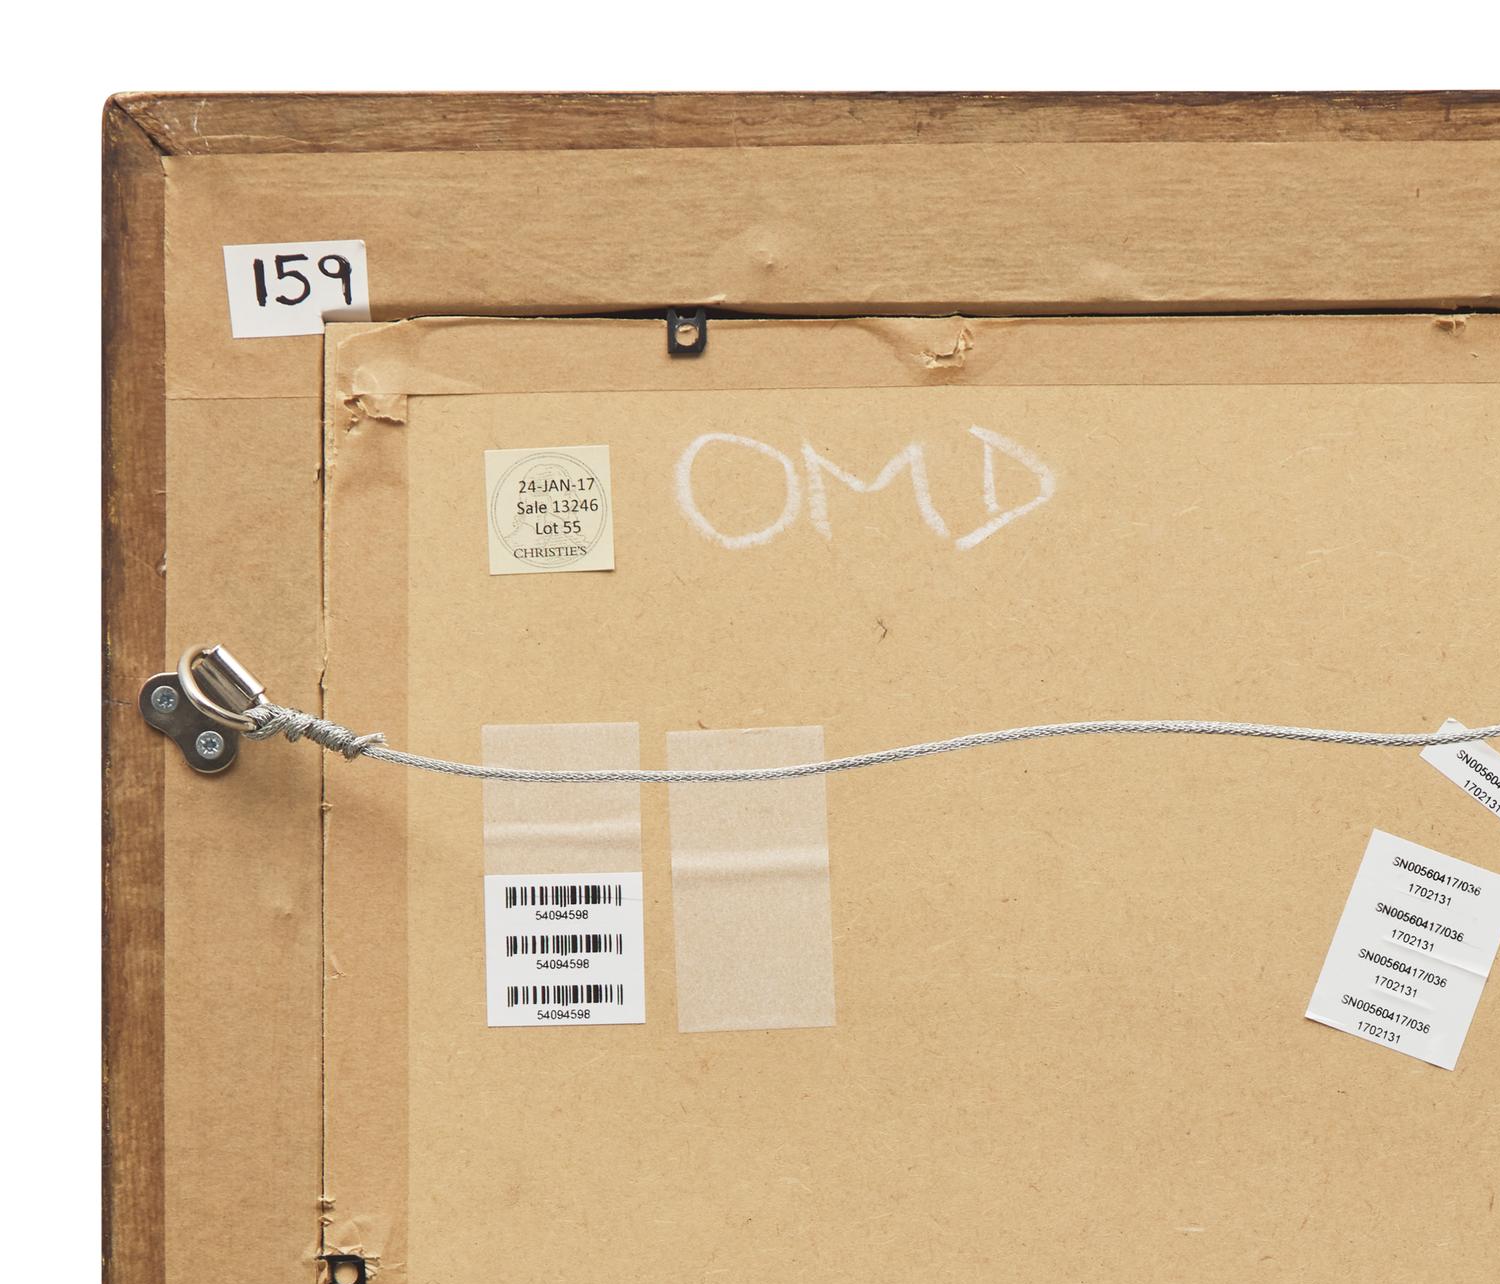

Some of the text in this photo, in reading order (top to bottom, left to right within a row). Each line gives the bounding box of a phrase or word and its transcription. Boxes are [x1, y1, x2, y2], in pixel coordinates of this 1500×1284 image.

[253, 254, 352, 307] 159
[519, 477, 595, 493] 24-JAN-17
[675, 423, 1056, 550] OMD
[517, 498, 599, 515] Sale 13246
[535, 520, 582, 535] Lot 55
[513, 545, 588, 559] CHRISTIE'S
[1392, 856, 1482, 897] SN00560417/036
[1408, 883, 1452, 907] 1702131
[535, 910, 589, 920] 54094598
[1375, 902, 1465, 942] SN00560417/036
[1391, 928, 1435, 952] 1702131
[536, 959, 590, 970] 54094598
[1358, 948, 1448, 988] SN00560417/036
[1374, 975, 1418, 998] 1702131
[537, 1009, 591, 1020] 54094598
[1340, 994, 1431, 1034] SN00560417/036
[1357, 1021, 1401, 1044] 1702131
